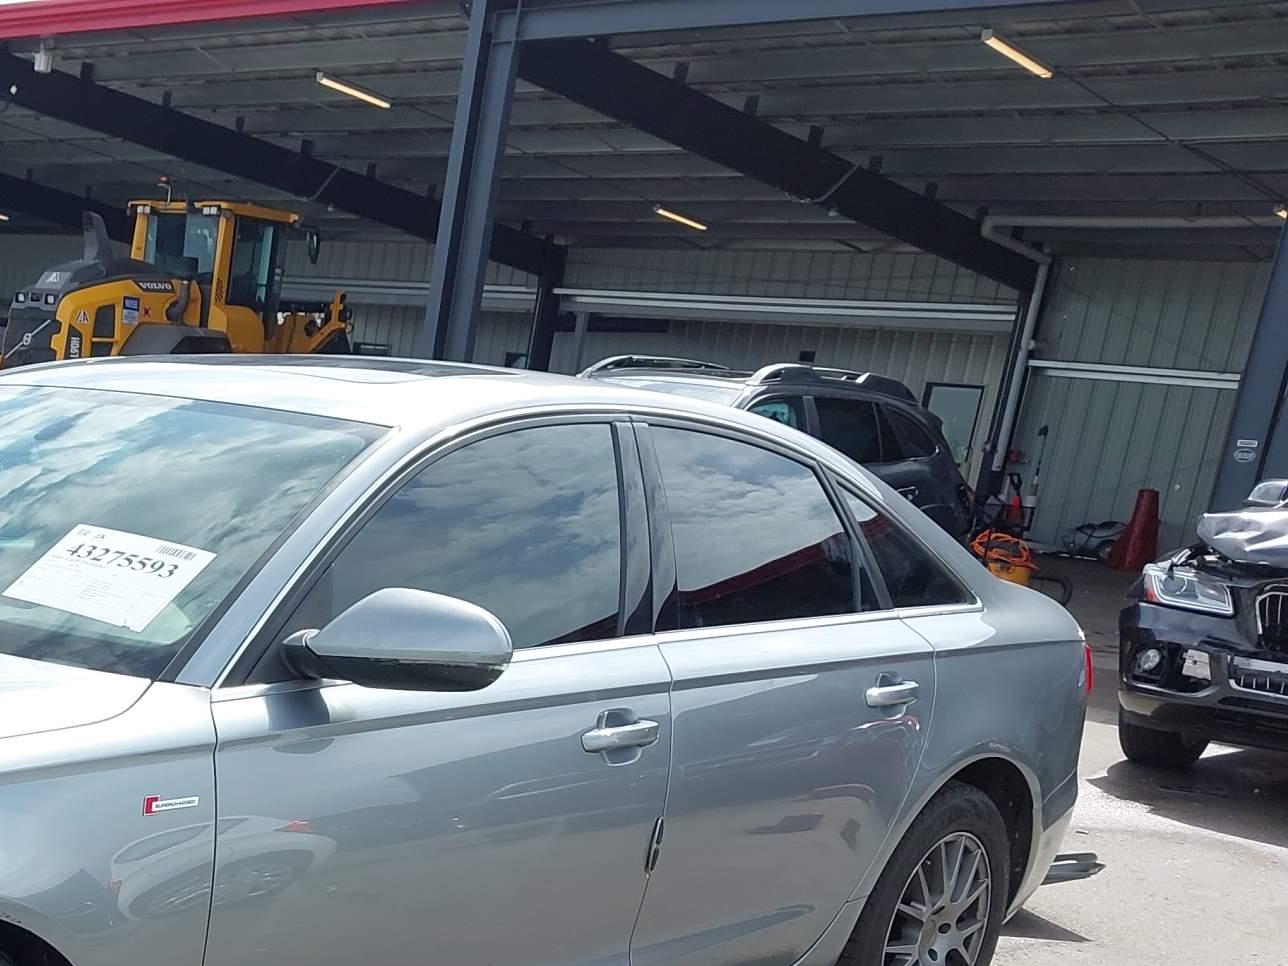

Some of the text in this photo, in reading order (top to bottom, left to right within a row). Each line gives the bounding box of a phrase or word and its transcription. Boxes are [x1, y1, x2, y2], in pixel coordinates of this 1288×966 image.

[138, 282, 172, 290] VOLVO
[70, 336, 80, 358] L90H
[66, 543, 179, 578] 43275593
